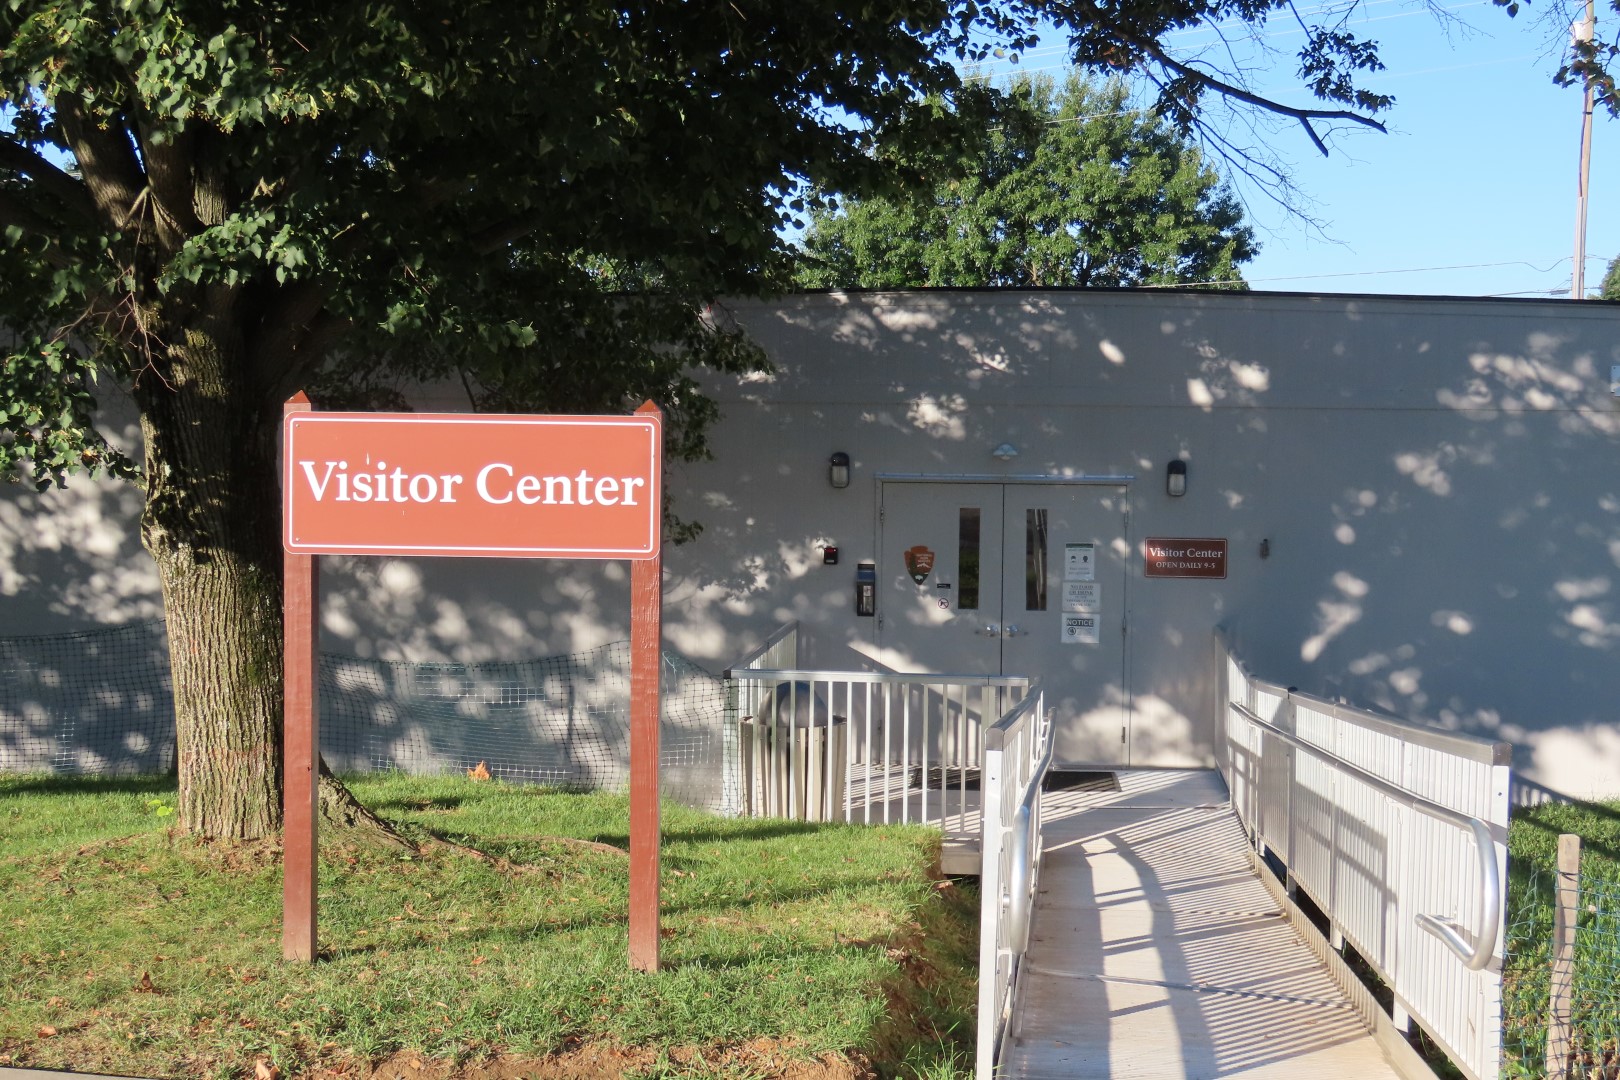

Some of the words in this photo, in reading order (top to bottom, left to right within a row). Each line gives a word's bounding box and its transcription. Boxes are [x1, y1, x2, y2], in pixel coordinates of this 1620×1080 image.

[299, 460, 463, 503] Visitor
[476, 463, 645, 506] Center
[1149, 547, 1184, 558] Visitor
[1186, 548, 1223, 558] Center
